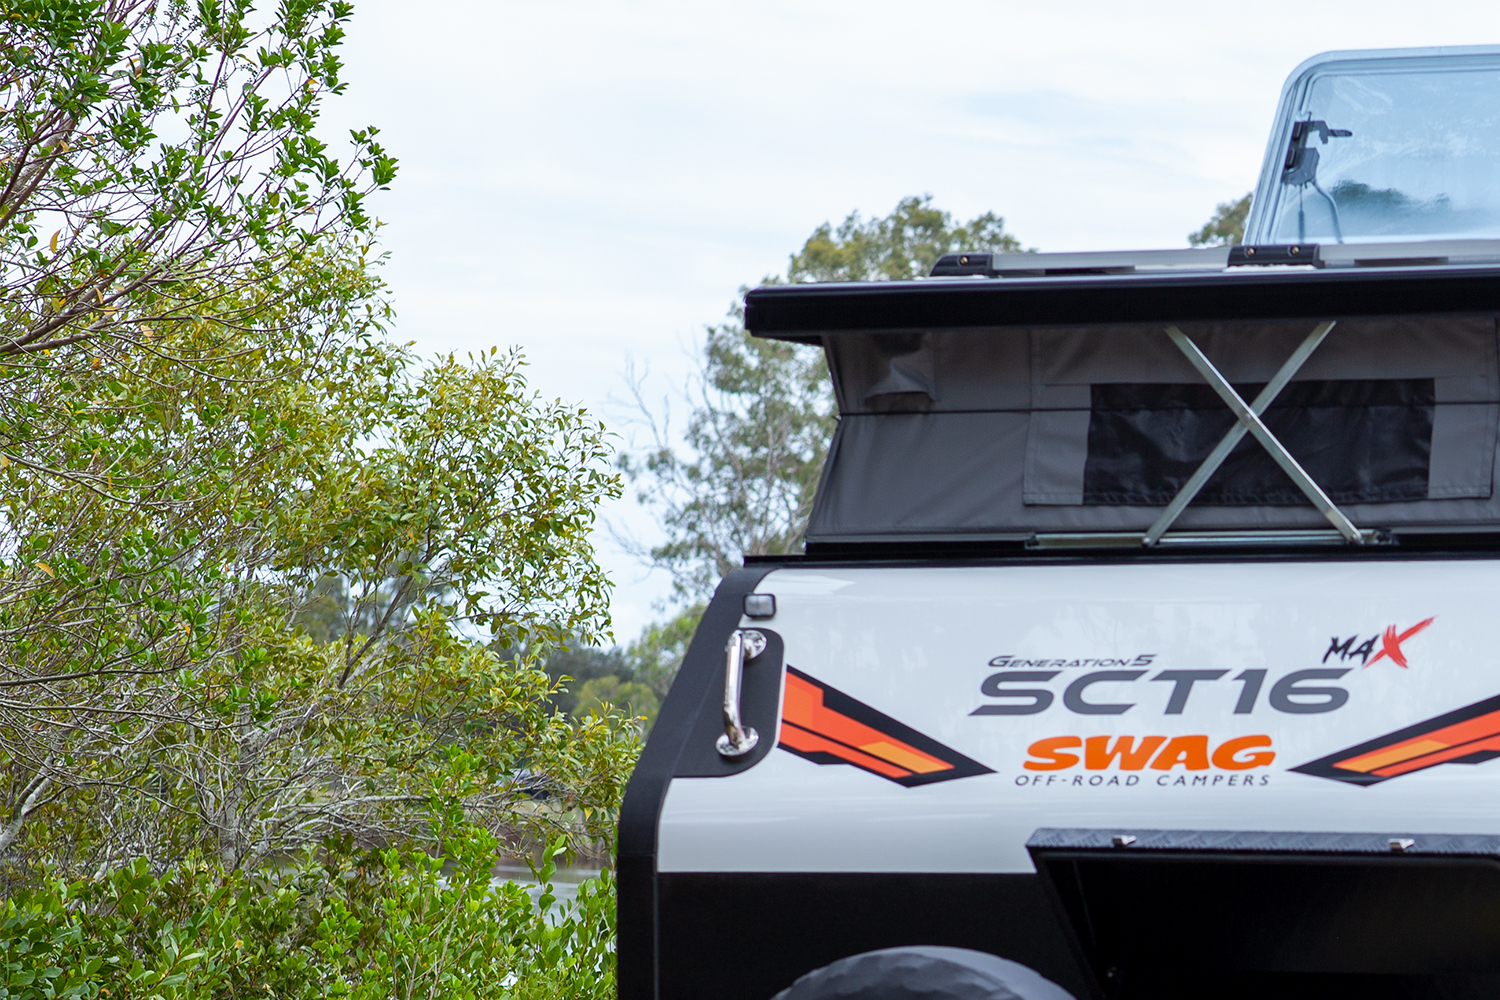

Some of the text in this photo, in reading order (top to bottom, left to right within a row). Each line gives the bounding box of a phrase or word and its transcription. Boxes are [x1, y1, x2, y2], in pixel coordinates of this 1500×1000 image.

[1321, 614, 1440, 669] MAX
[967, 667, 1355, 717] SCT16
[1022, 734, 1277, 772] SWAG
[1014, 774, 1271, 788] OFF-ROAD CAMPERS
